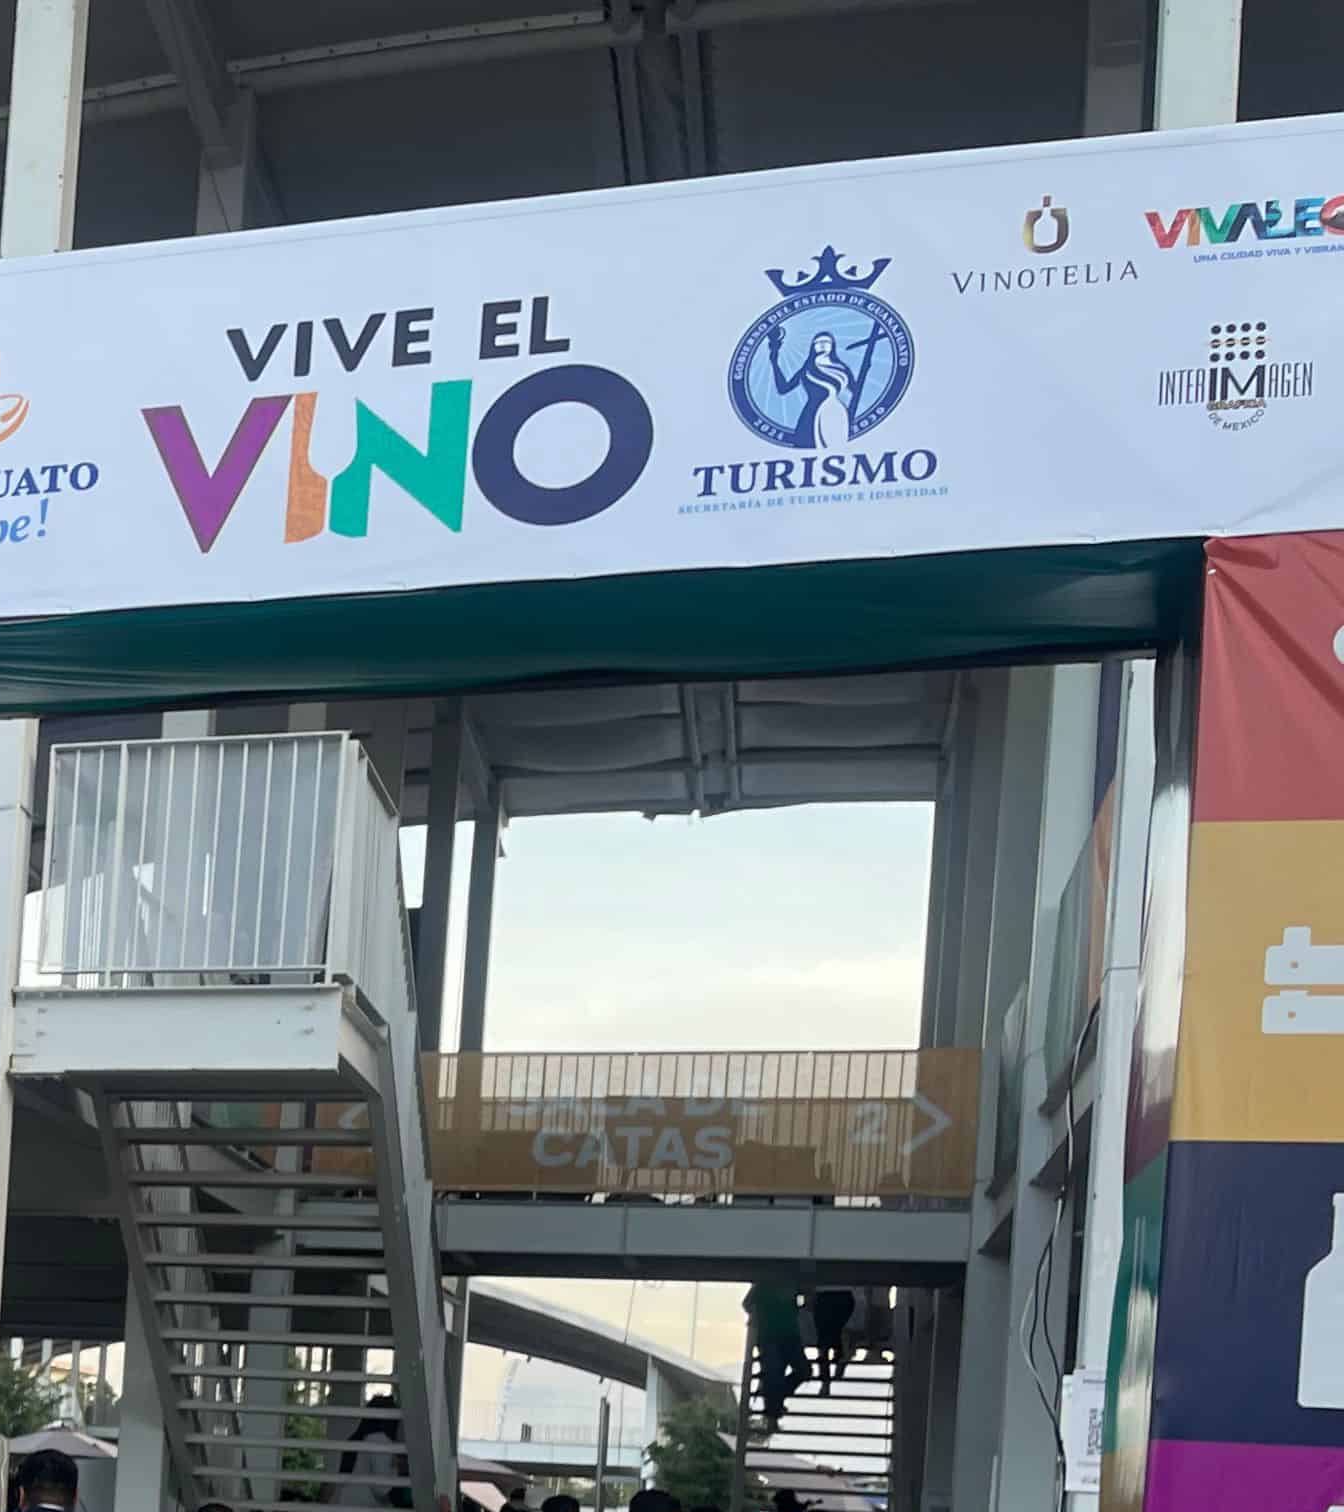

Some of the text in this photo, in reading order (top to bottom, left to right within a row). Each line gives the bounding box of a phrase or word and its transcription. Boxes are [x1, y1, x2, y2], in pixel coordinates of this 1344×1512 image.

[1266, 247, 1291, 258] VIVA
[952, 261, 1139, 295] VINOTELIA
[227, 296, 571, 381] VIVE EL
[768, 303, 791, 325] DEL
[794, 293, 846, 309] ESTADO
[849, 294, 866, 305] DE
[867, 301, 909, 367] GUANAJUATO
[141, 364, 654, 554] VINO
[693, 450, 937, 497] TURISMO
[768, 496, 784, 507] DE
[532, 1126, 735, 1168] CATAS
